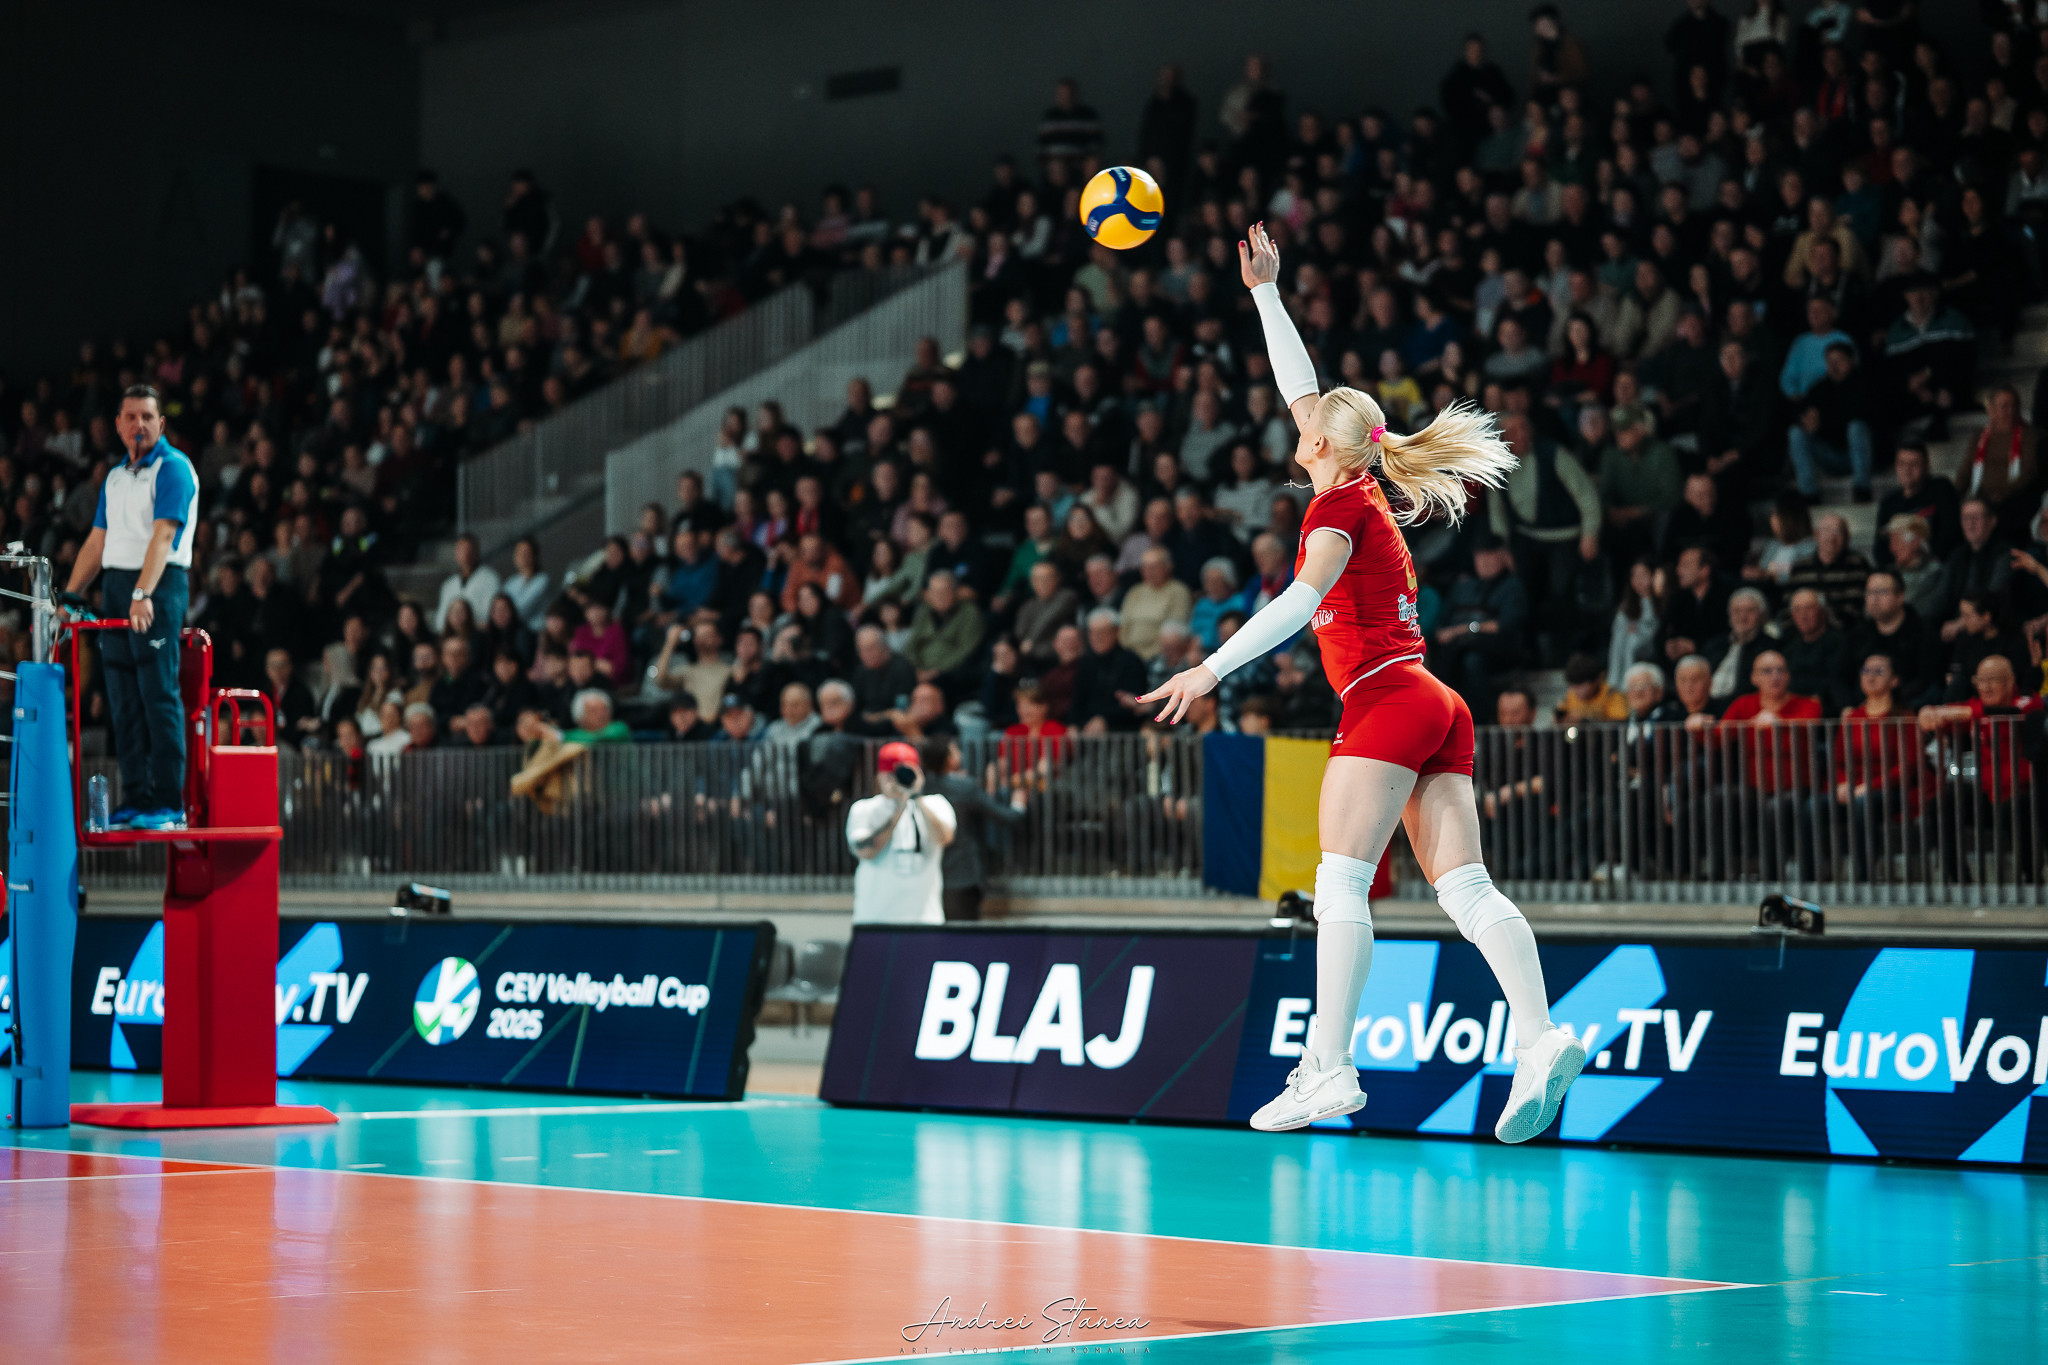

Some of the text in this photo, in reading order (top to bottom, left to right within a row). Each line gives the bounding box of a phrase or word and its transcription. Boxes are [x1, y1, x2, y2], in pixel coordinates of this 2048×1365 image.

[495, 971, 710, 1016] CEV Volleyball Cup
[914, 961, 1155, 1069] BLAJ
[486, 1007, 544, 1040] 2025
[1779, 1011, 2048, 1085] EuroVol
